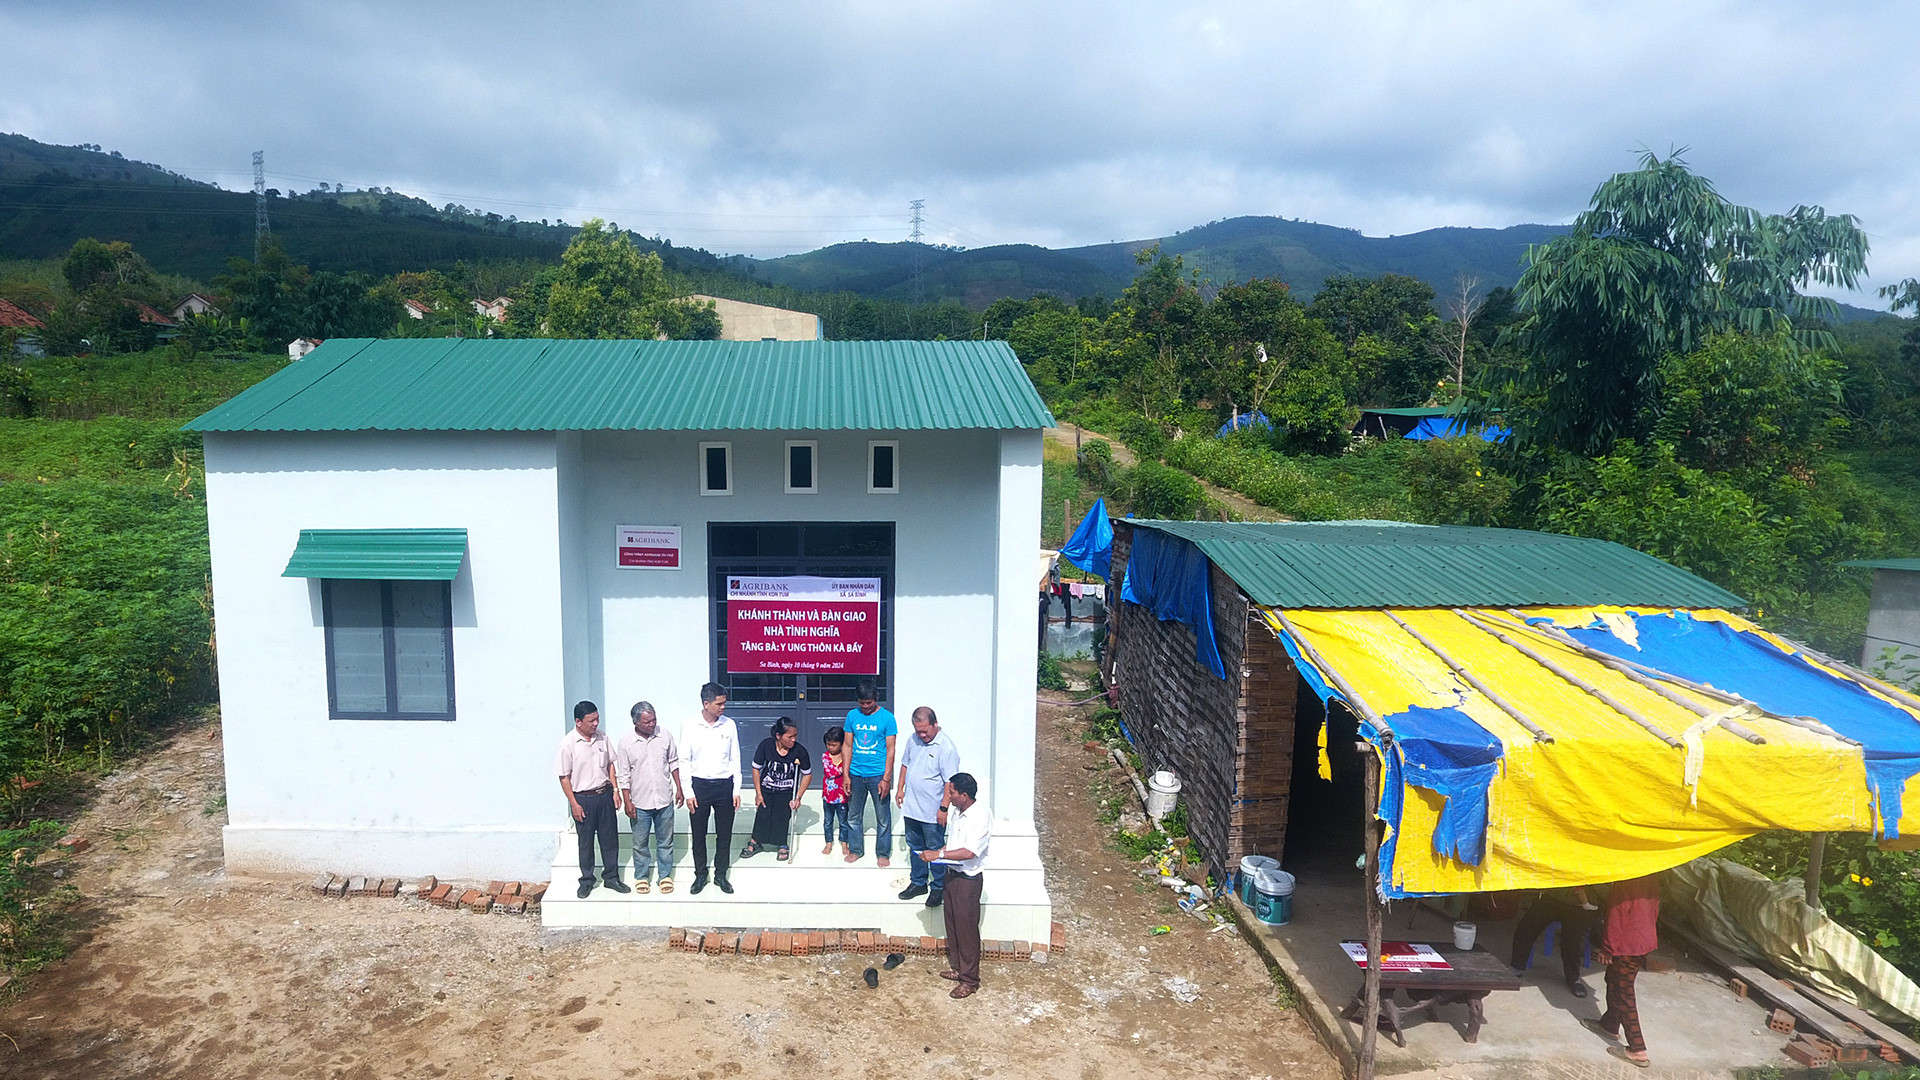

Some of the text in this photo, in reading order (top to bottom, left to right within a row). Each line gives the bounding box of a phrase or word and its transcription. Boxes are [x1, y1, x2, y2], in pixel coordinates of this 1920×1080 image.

[738, 609, 867, 622] KHÁNH THÀNH VÀ BÀN GIAO
[764, 624, 840, 637] NHÀ TÌNH NGHĨA
[741, 640, 764, 653] TẶNG
[765, 641, 779, 651] BÀ:
[780, 643, 787, 651] Y
[788, 643, 807, 652] UNG
[808, 642, 832, 652] THÔN
[833, 641, 845, 652] KÀ
